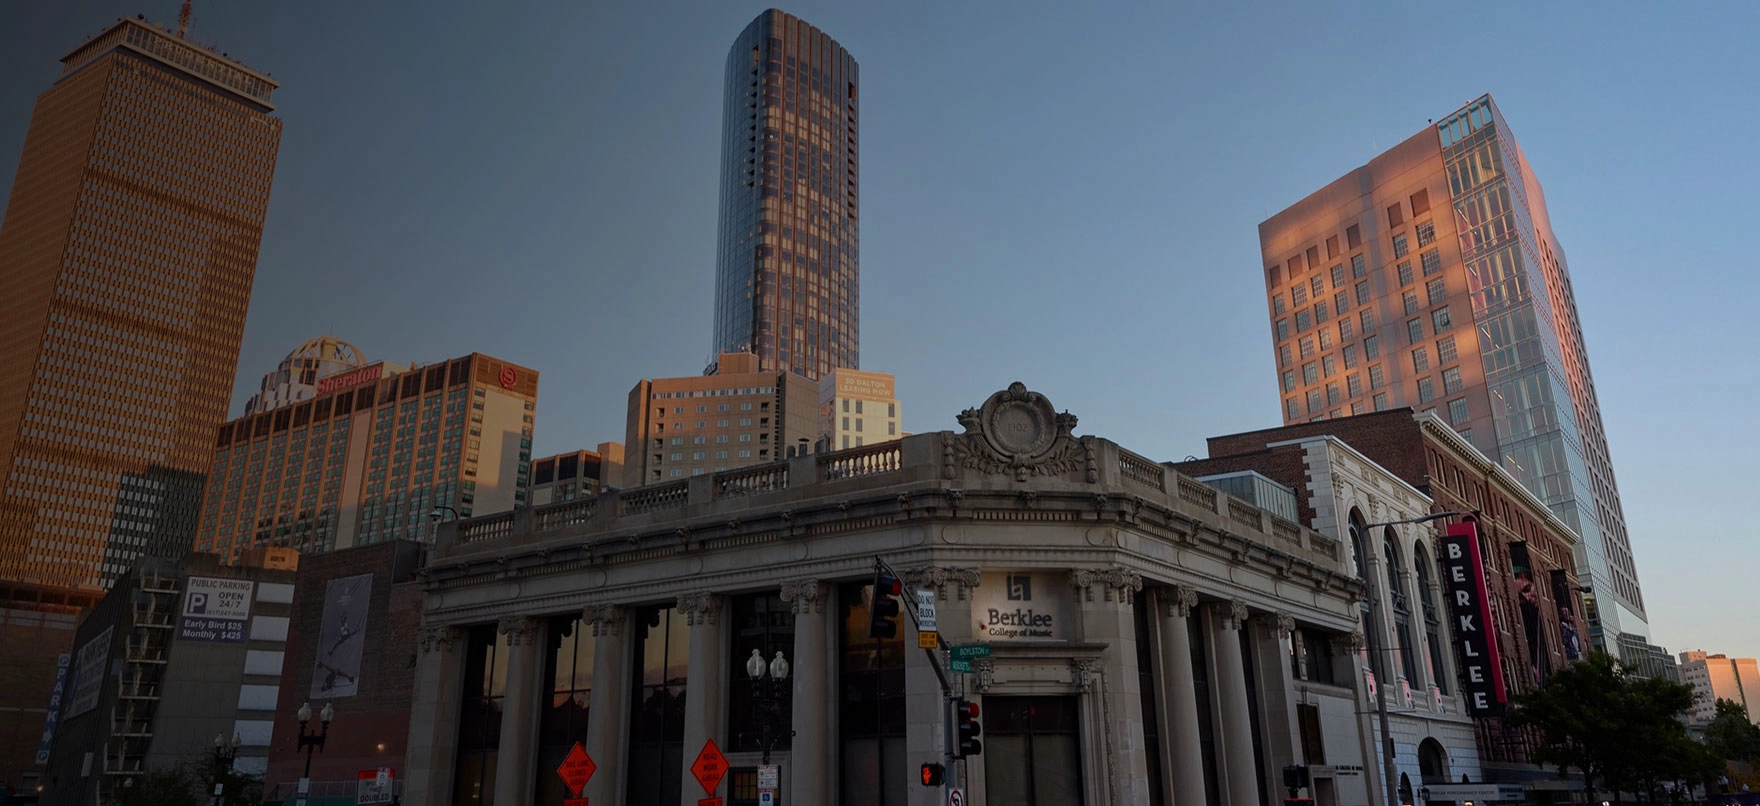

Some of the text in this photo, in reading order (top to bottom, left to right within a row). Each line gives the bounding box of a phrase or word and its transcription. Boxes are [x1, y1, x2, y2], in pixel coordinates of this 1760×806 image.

[317, 365, 382, 394] Sheraton
[856, 378, 886, 388] DALTON
[839, 385, 891, 397] LEASING NOW
[191, 579, 250, 591] PUBLIC PARKING
[218, 592, 244, 600] OPEN
[918, 595, 934, 605] DO NOT
[219, 600, 241, 608] 24/7
[919, 608, 934, 618] BLOCK
[988, 608, 1052, 627] Berklee
[184, 620, 242, 631] Early Bird $25
[1447, 543, 1489, 710] BERKLEE
[182, 629, 241, 640] Monthly $425
[989, 628, 1053, 639] College of Music
[960, 647, 985, 656] BOYLSTON
[46, 668, 66, 722] PARK
[702, 773, 719, 781] AHEAD
